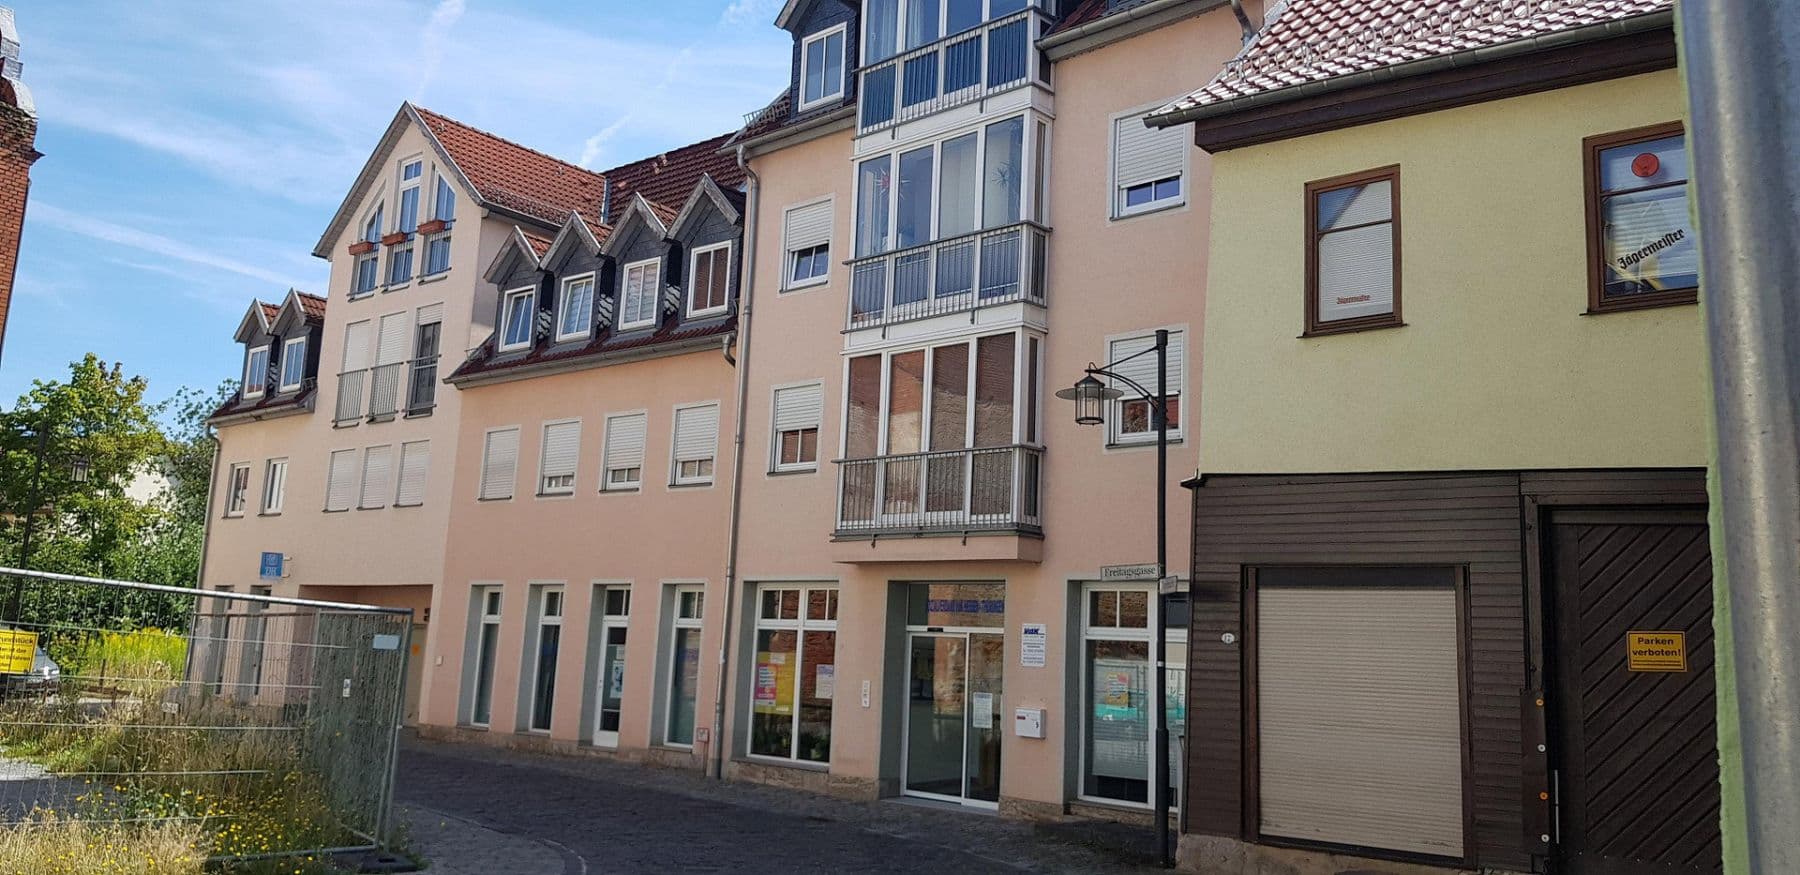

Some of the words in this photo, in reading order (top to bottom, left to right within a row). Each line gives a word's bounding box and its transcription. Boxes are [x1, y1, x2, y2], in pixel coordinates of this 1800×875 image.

[1104, 567, 1156, 577] Freitagsgasse
[1637, 637, 1674, 645] Parken
[1632, 648, 1681, 656] verboten!
